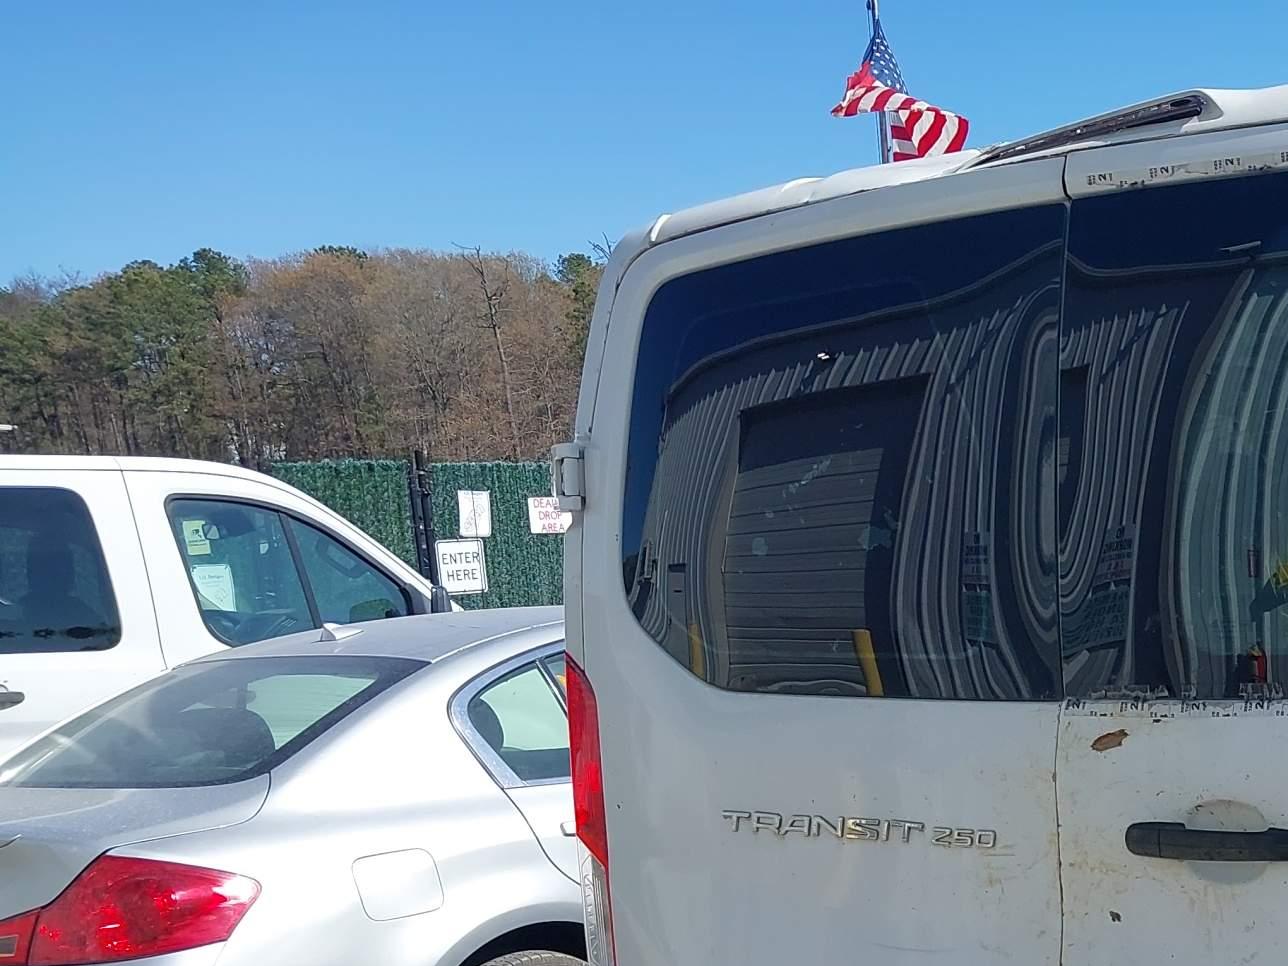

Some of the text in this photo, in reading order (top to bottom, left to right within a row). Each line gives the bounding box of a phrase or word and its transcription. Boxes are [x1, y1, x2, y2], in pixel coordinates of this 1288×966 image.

[541, 522, 565, 533] AREA
[441, 552, 480, 565] ENTER
[446, 568, 479, 582] HERE
[721, 809, 997, 849] TRANSIT 250
